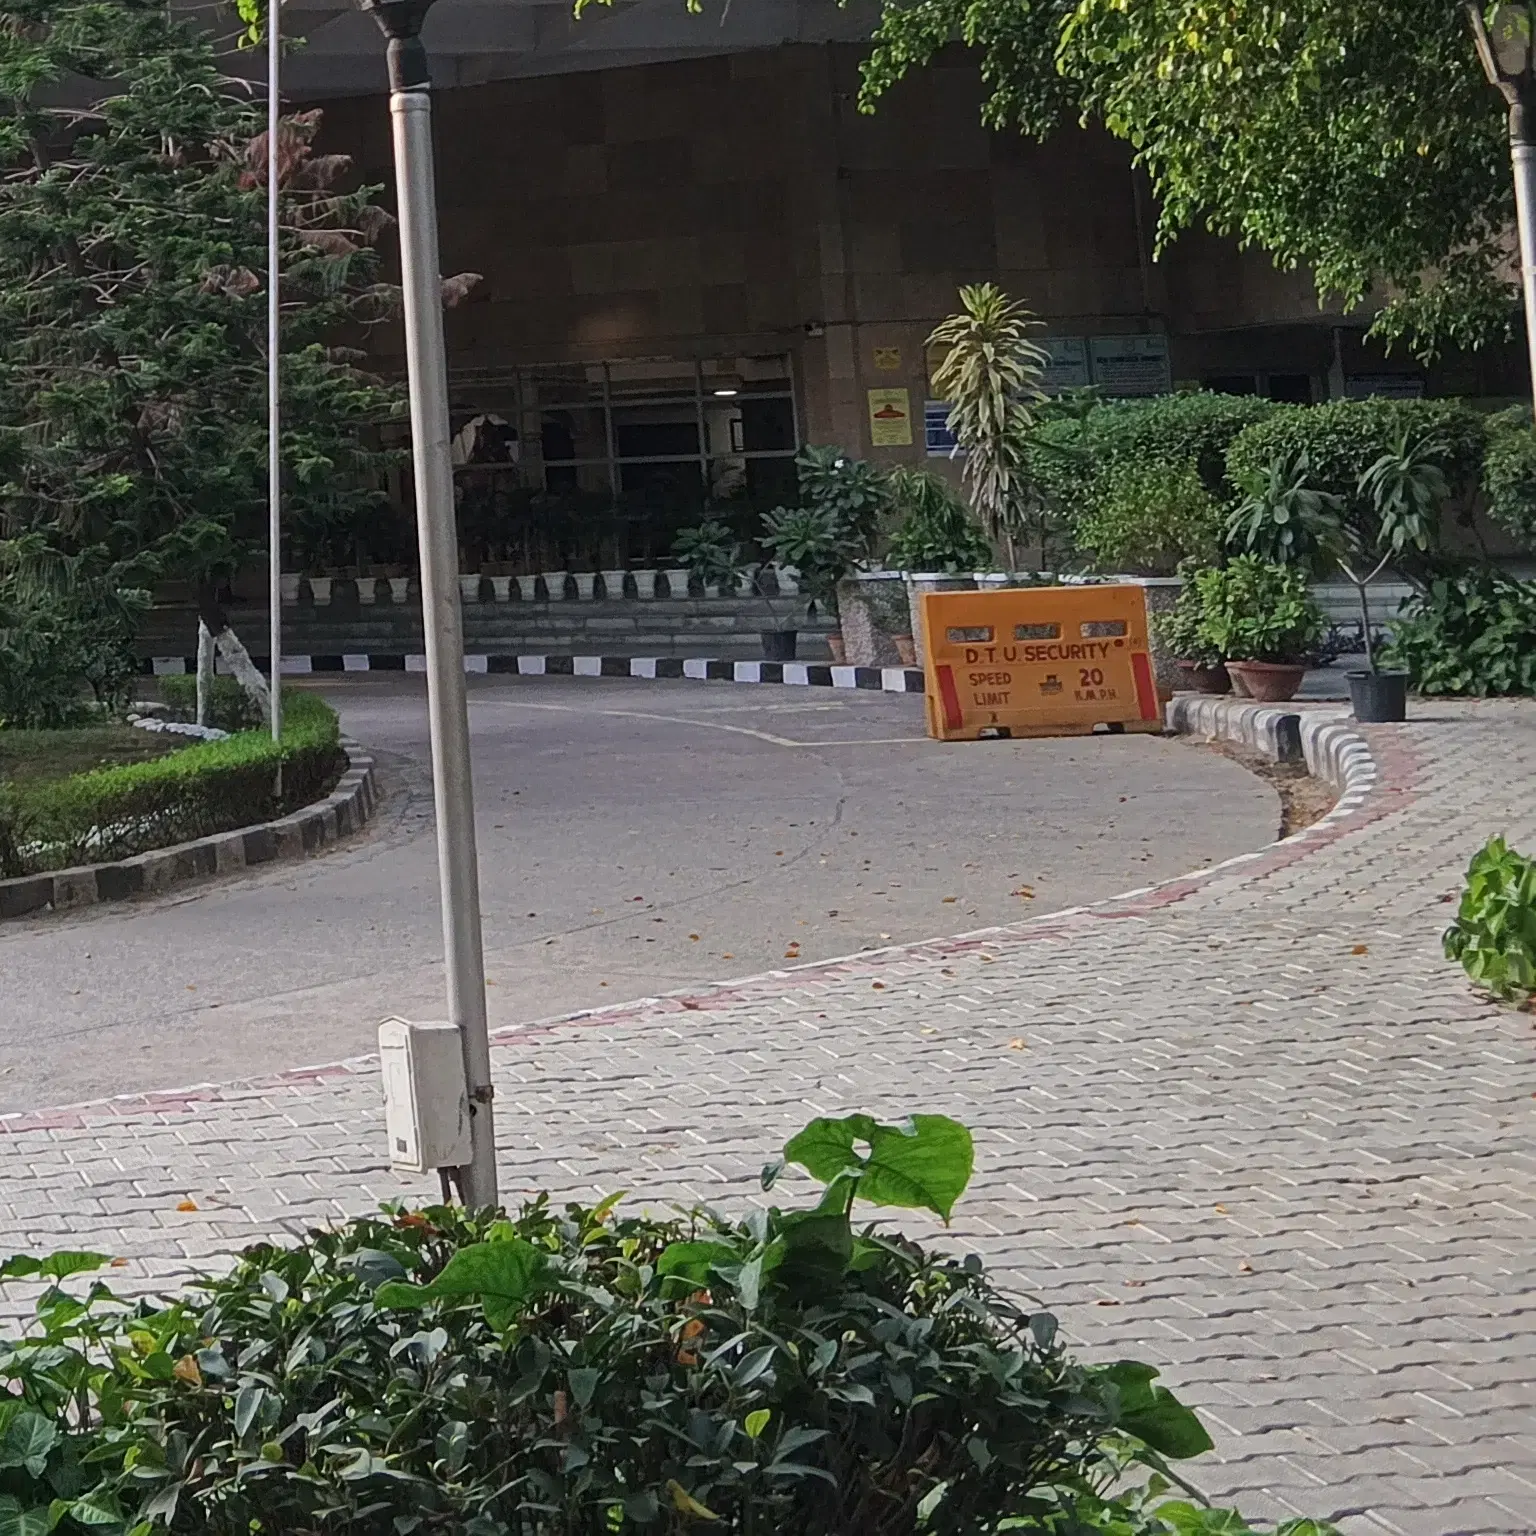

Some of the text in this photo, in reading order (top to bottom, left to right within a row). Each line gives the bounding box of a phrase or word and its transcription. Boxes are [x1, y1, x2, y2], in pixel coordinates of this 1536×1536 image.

[1024, 642, 1110, 662] SECURITY
[969, 672, 1012, 686] SPEED
[1079, 668, 1104, 687] 20
[974, 691, 1011, 706] LIMIT
